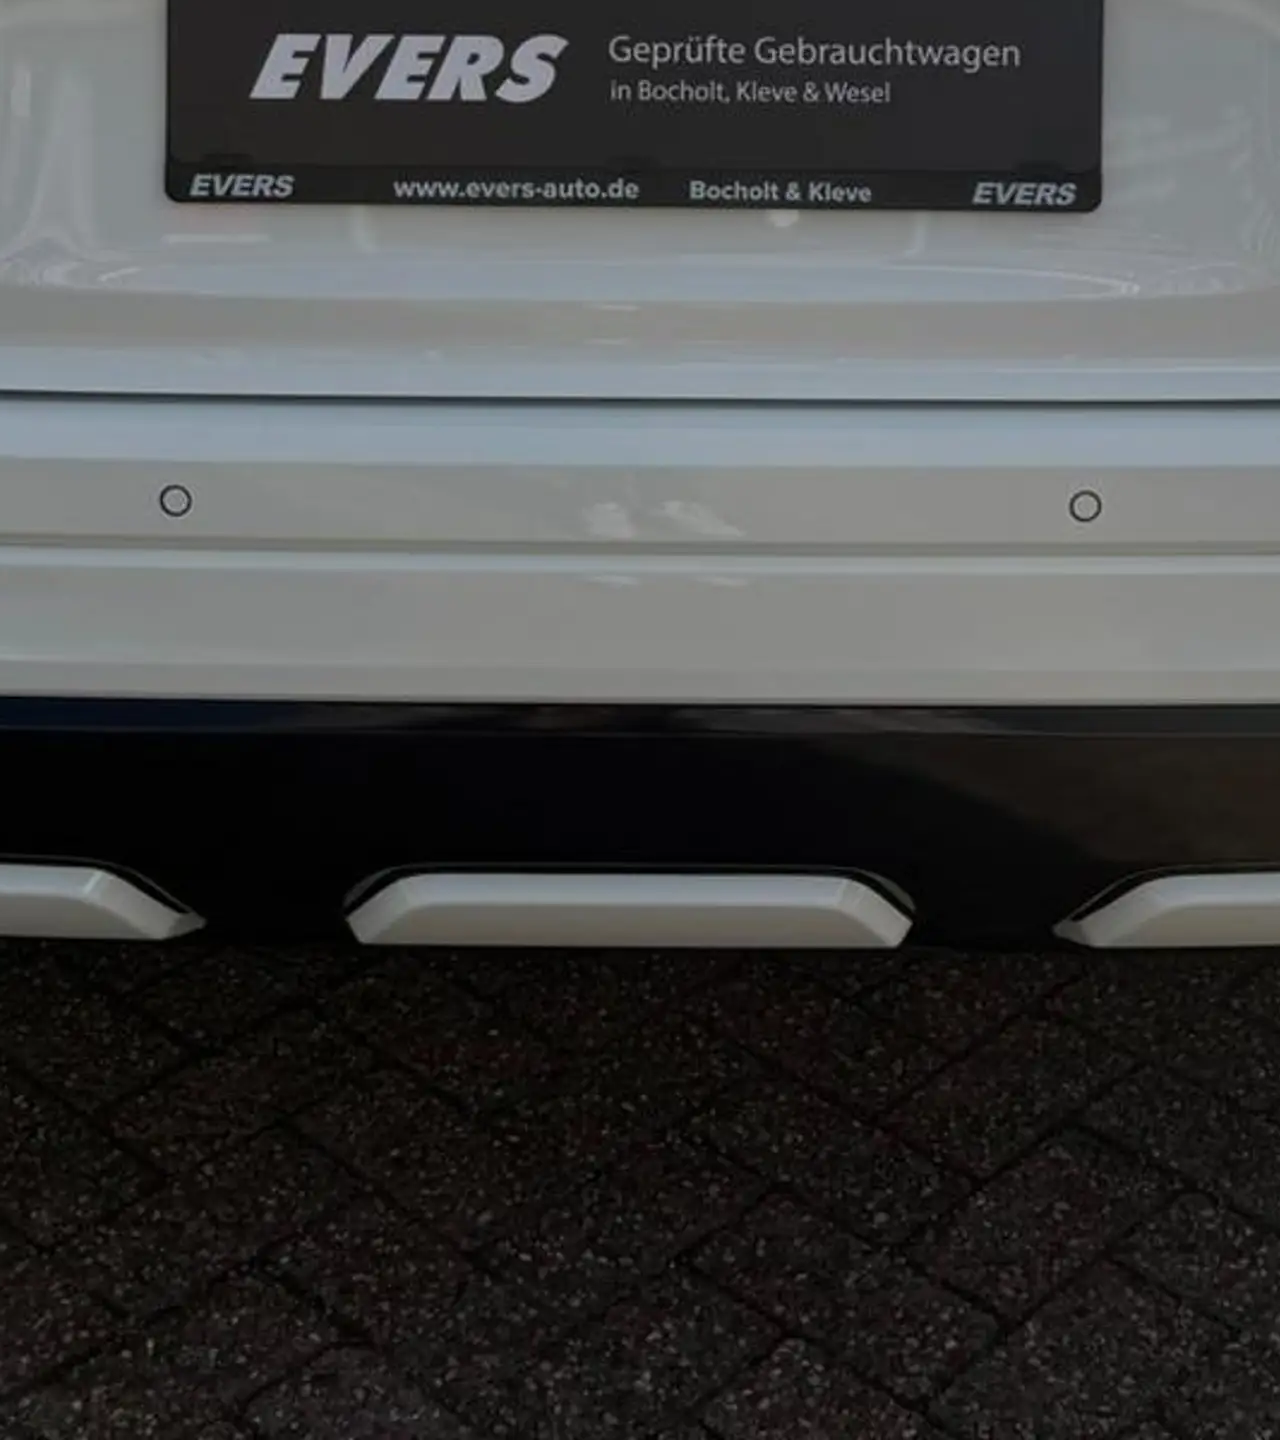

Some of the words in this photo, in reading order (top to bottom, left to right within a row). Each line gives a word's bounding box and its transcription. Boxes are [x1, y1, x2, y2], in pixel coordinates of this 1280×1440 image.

[608, 35, 746, 70] Geprüfte
[754, 35, 1022, 73] Gebrauchtwagen
[248, 32, 570, 104] EVERS
[609, 79, 632, 100] in
[637, 79, 730, 104] Bocholt,
[736, 80, 797, 103] Kleve
[802, 82, 822, 103] &
[824, 81, 892, 104] Wesel
[188, 173, 295, 198] EVERS
[393, 177, 640, 200] www.evers-auto.de
[689, 180, 779, 202] Bocholt
[784, 181, 802, 202] &
[809, 181, 872, 203] Kleve
[971, 181, 1078, 206] EVERS
